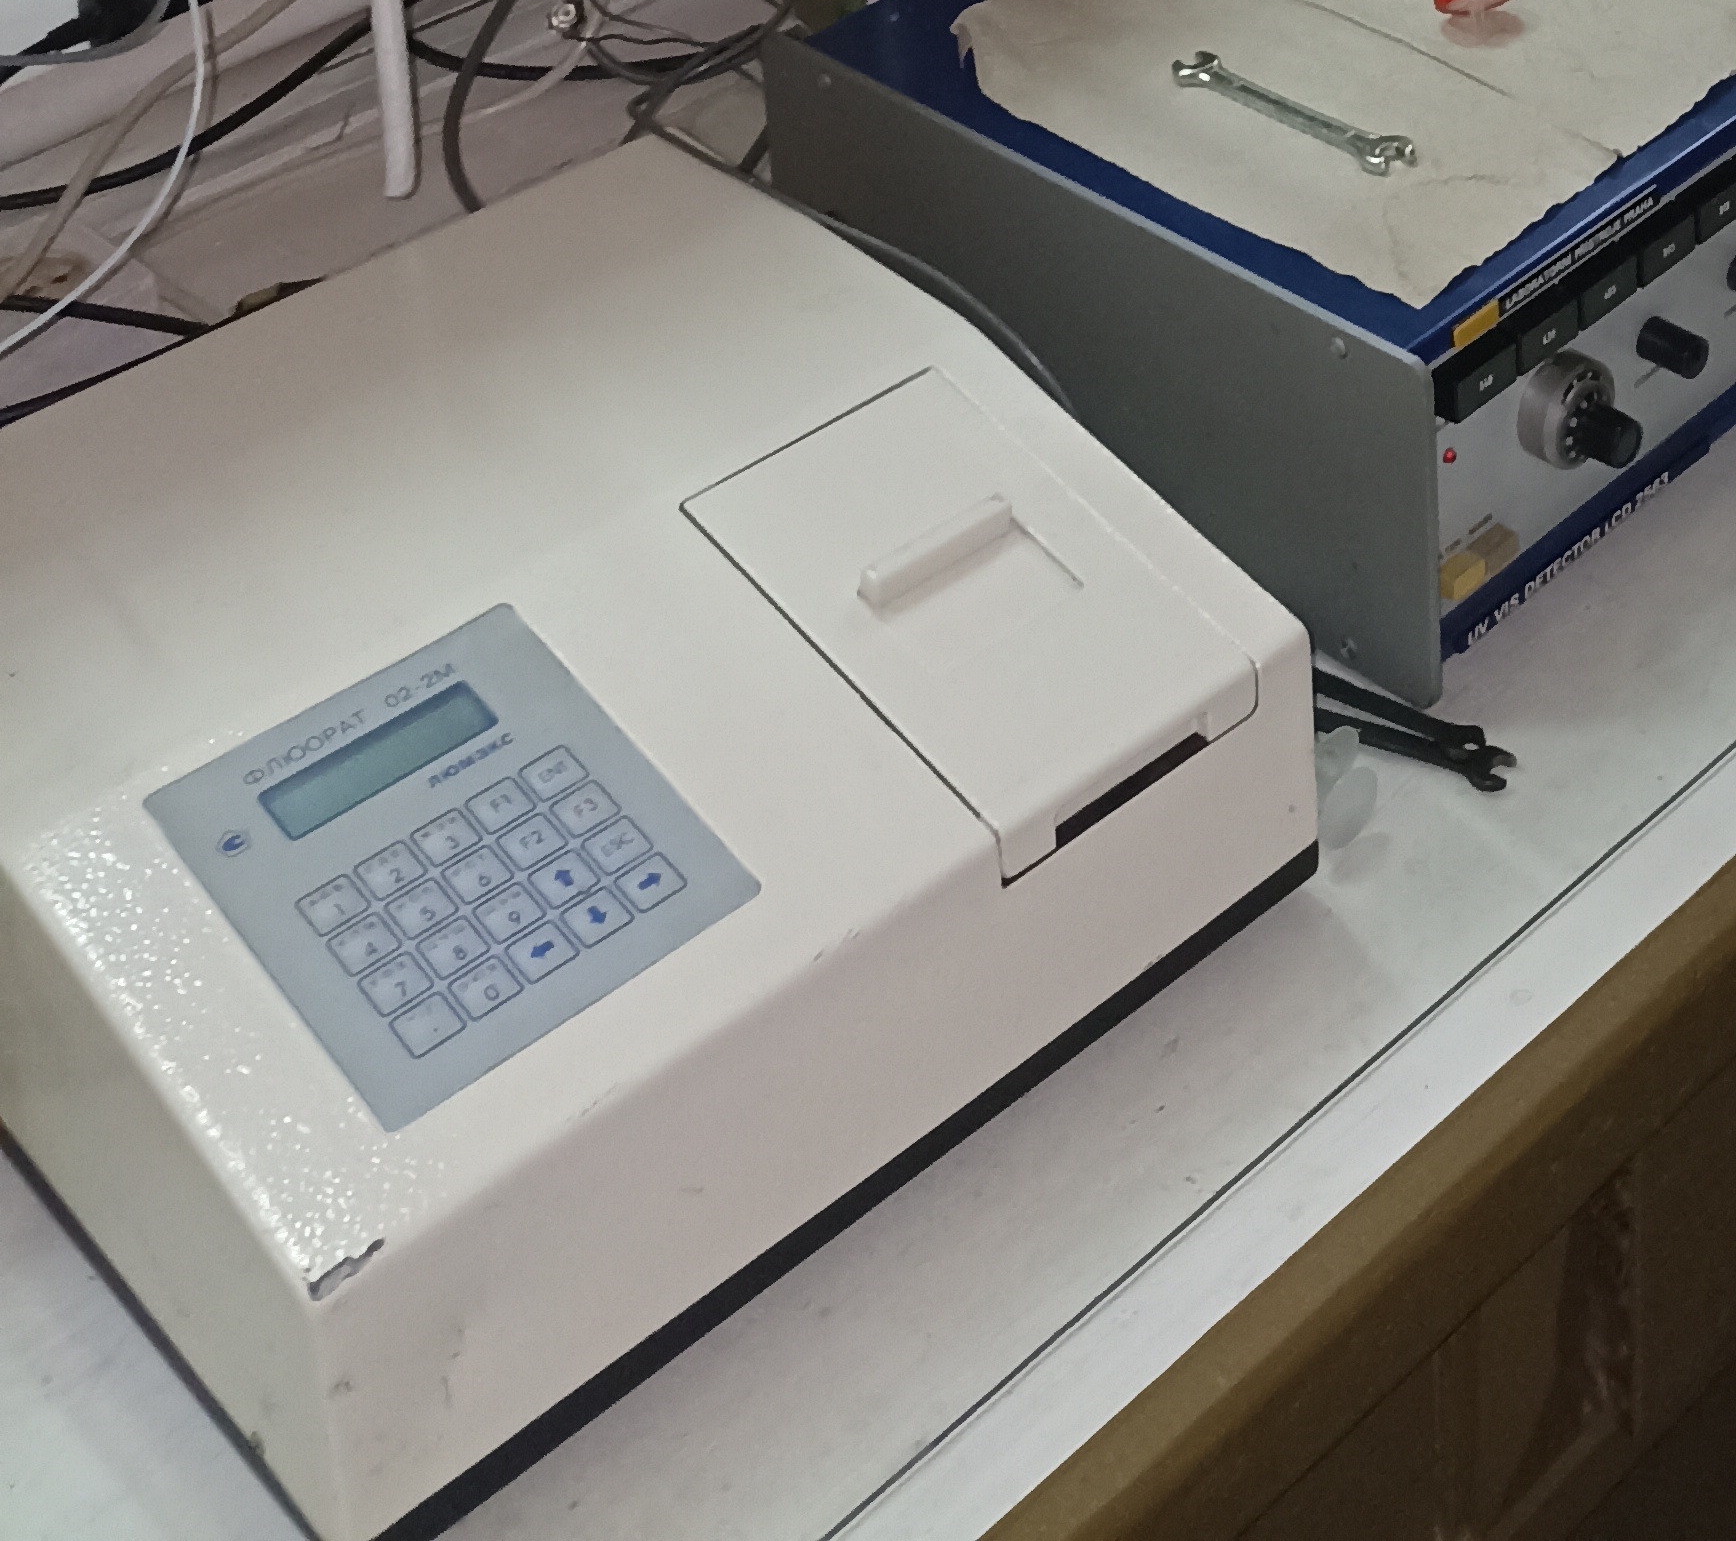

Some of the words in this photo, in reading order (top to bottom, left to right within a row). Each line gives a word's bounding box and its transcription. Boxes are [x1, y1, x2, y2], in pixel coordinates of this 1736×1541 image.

[1623, 196, 1655, 224] PRAHA
[1524, 527, 1601, 600] DETECTOR
[1604, 502, 1632, 533] LCD
[241, 708, 366, 786] ФЛЮОРАТ
[573, 797, 599, 817] F3
[518, 830, 545, 851] F2
[389, 867, 405, 884] 2
[507, 910, 521, 926] 9
[452, 944, 469, 961] 8
[394, 980, 407, 998] 7
